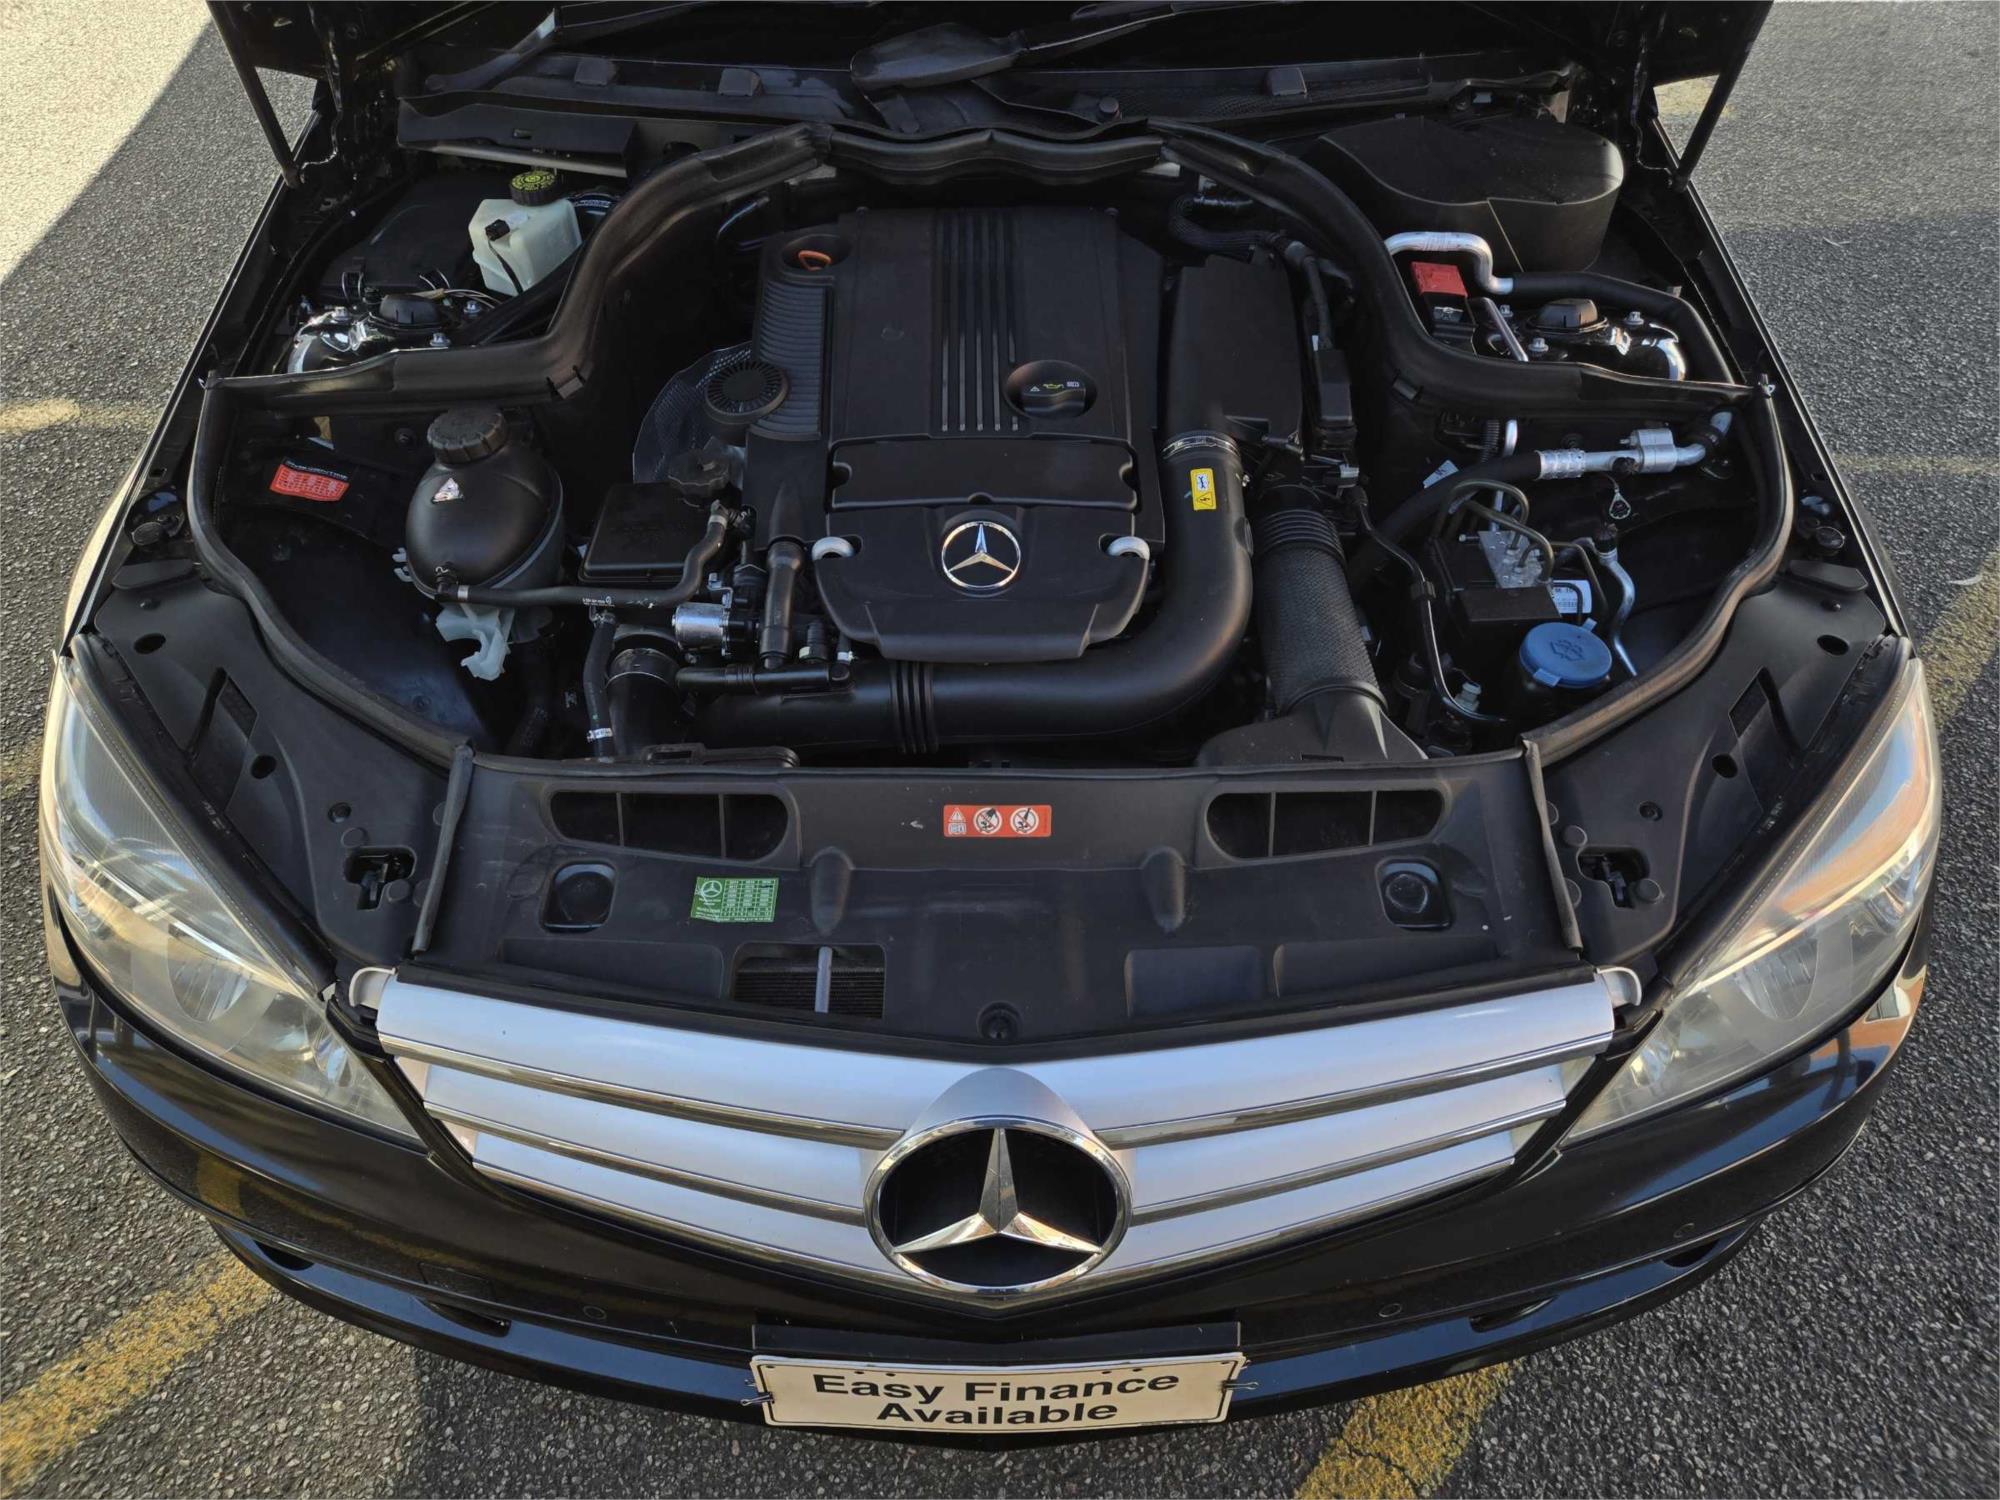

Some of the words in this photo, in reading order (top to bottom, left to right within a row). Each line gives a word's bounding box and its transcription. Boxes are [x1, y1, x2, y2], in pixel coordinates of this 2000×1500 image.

[813, 1374, 943, 1404] Easy
[965, 1373, 1180, 1402] Finance
[876, 1402, 1118, 1424] Available
